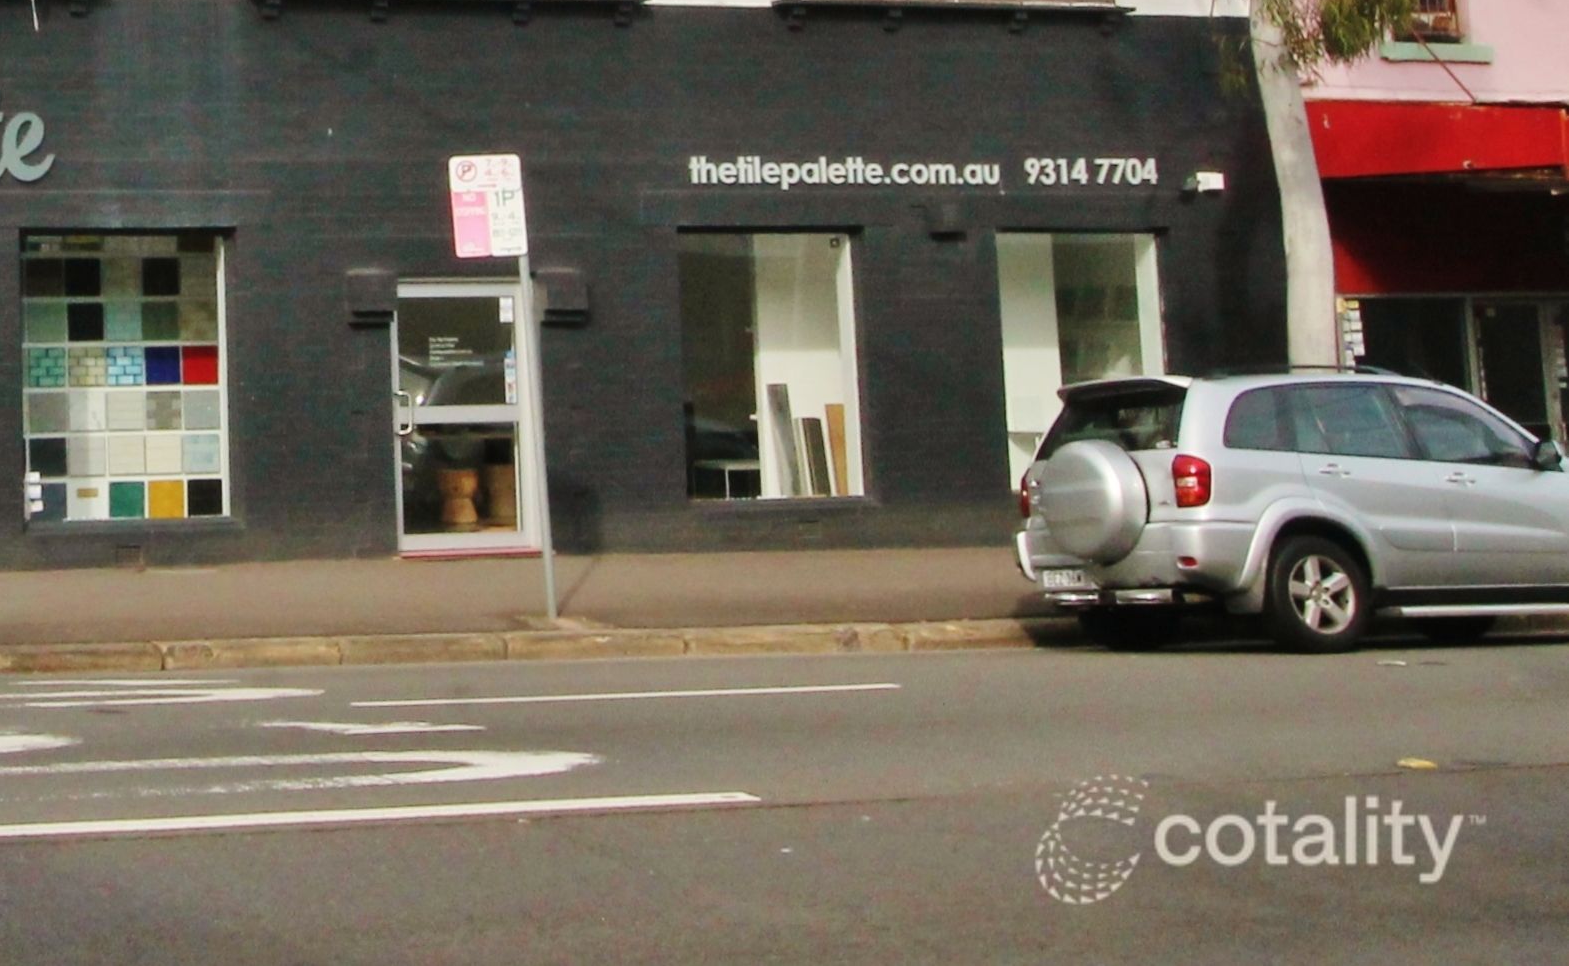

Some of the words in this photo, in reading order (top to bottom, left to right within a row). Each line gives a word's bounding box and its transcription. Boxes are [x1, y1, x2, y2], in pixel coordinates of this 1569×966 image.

[689, 156, 1000, 190] thetilepalette.com.au
[1024, 158, 1089, 185] 9314
[1094, 158, 1159, 185] 7704
[494, 188, 516, 207] 1P
